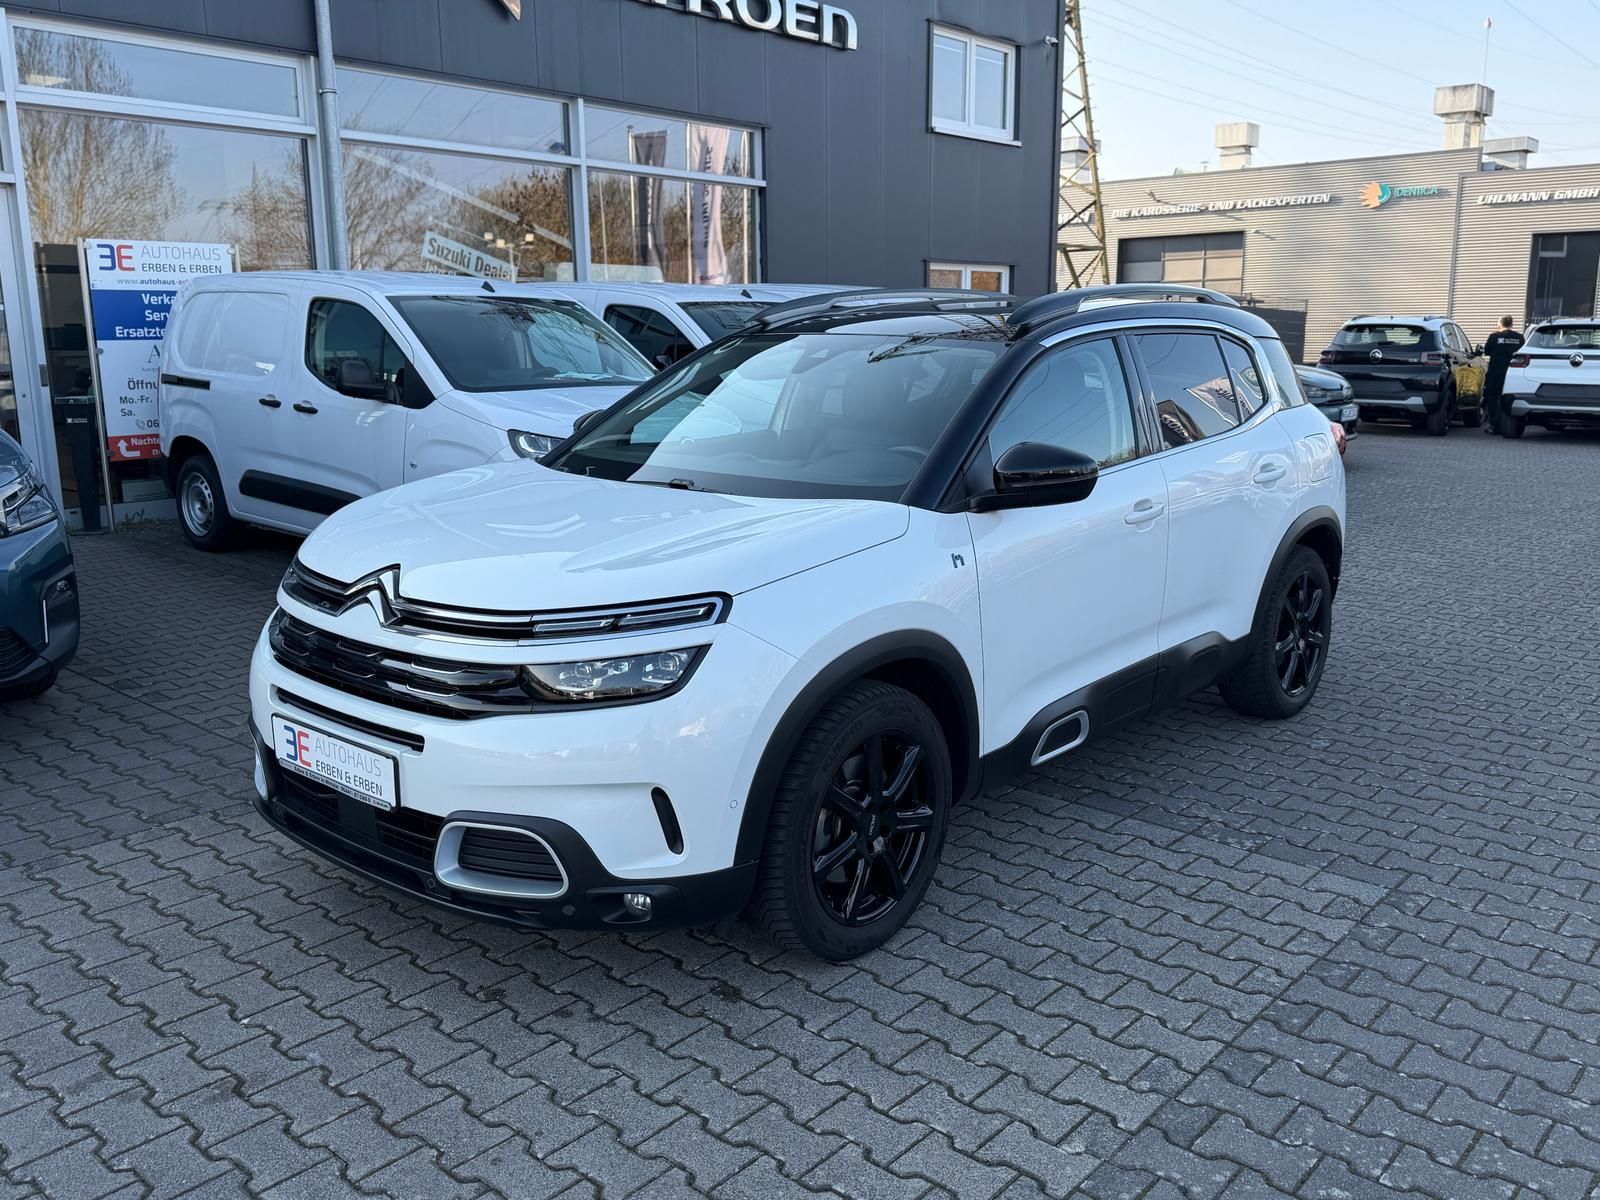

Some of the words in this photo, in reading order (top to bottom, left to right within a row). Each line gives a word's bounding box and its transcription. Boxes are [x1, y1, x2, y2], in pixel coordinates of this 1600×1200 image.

[1393, 185, 1438, 198] IDENTICA
[1478, 191, 1550, 205] UHLMANN
[1553, 187, 1600, 200] GMBH
[1112, 208, 1131, 219] DIE
[1208, 200, 1235, 211] UND
[1236, 193, 1331, 209] LACKEXPERTEN
[141, 245, 221, 261] AUTOHAUS
[427, 237, 473, 270] Suzuki
[141, 262, 176, 273] ERBEN
[178, 264, 187, 273] &
[189, 264, 222, 274] ERBEN
[119, 396, 153, 405] Mo.-Fr.
[120, 408, 136, 417] Sa.
[315, 737, 381, 777] AUTOHAUS
[315, 760, 343, 781] ERBEN
[345, 771, 352, 785] &
[353, 775, 383, 796] ERBEN
